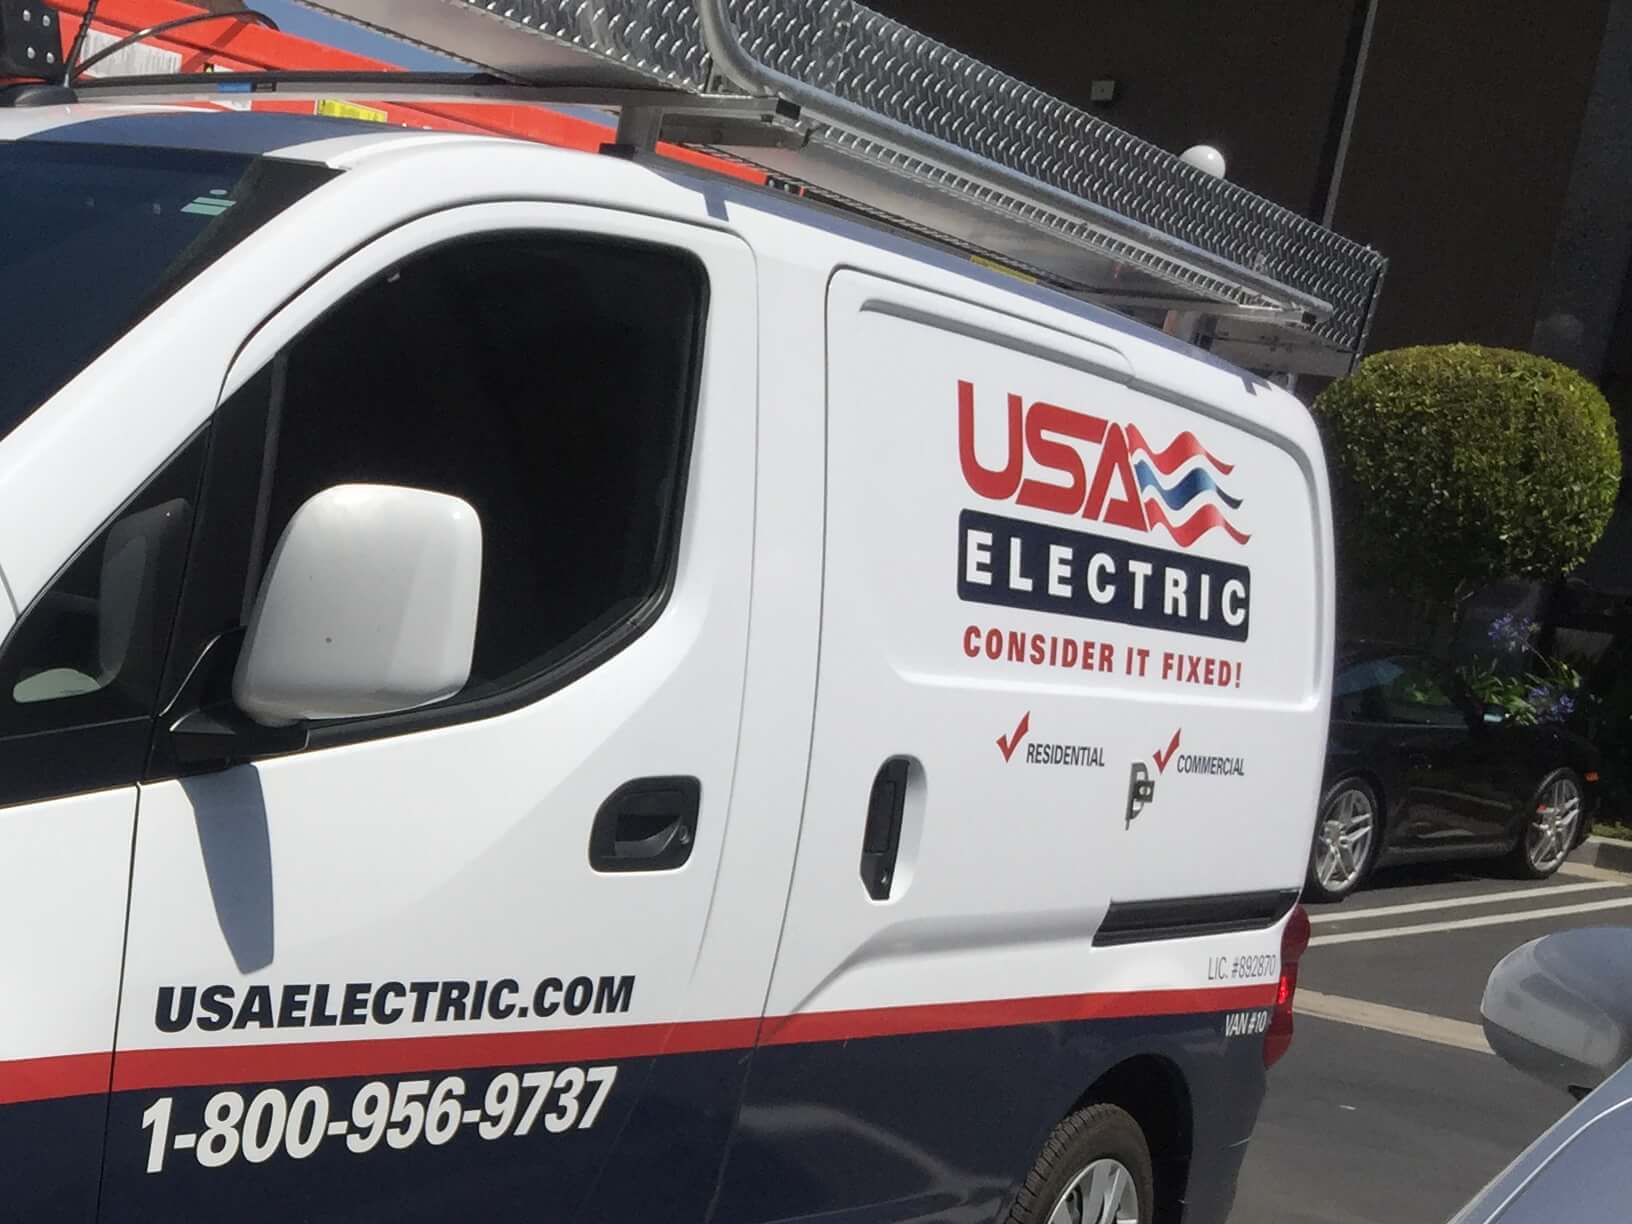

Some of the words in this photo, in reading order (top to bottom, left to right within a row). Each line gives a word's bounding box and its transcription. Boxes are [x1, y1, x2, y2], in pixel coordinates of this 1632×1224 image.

[957, 379, 1149, 532] USA
[966, 529, 1247, 627] ELECTRIC
[963, 625, 1114, 672] CONSIDER
[1126, 648, 1150, 677] IT
[1162, 652, 1242, 688] FIXED!
[1026, 742, 1105, 767] RESIDENTIAL
[1177, 755, 1245, 776] COMMERCIAL
[1208, 957, 1228, 980] LIC.
[1232, 954, 1276, 978] #892870
[155, 975, 636, 1032] USAELECTRIC.COM
[141, 1066, 618, 1173] 1-800-956-9737
